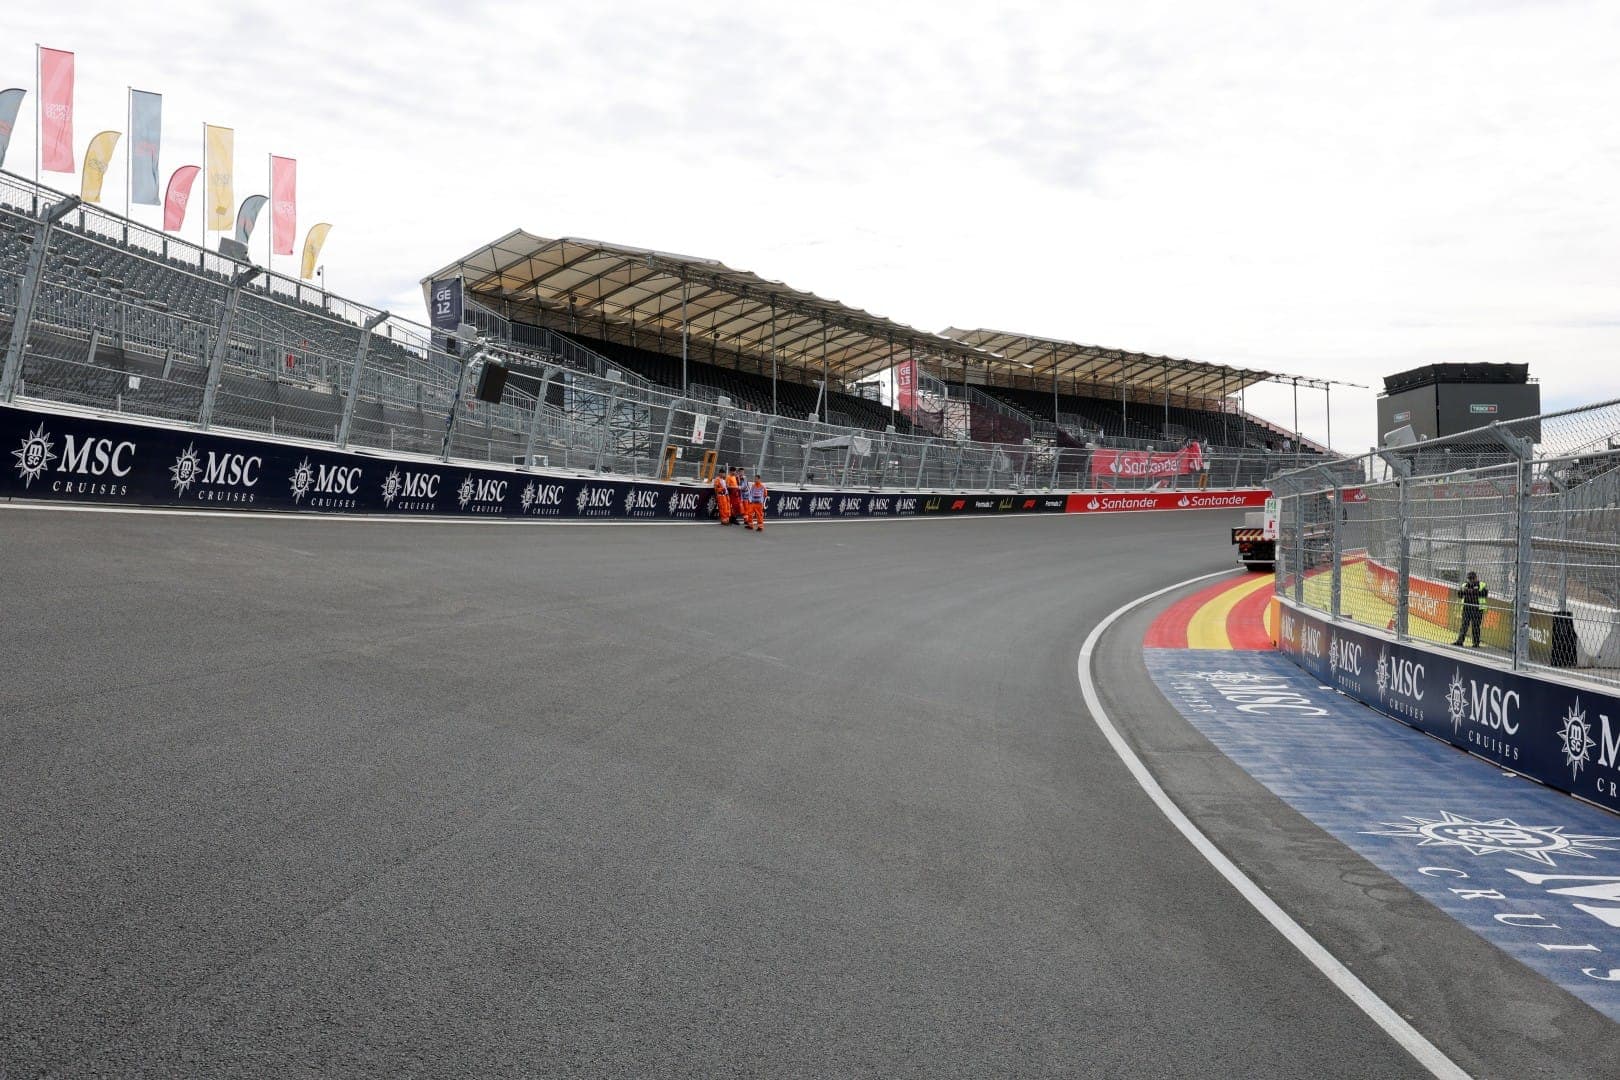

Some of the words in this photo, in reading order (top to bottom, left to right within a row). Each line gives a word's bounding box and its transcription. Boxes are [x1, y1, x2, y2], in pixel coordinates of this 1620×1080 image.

[437, 290, 451, 301] GE
[437, 302, 450, 315] 12
[56, 434, 136, 477] MSC
[202, 451, 262, 487] MSC
[52, 481, 127, 495] CRUISES
[314, 464, 362, 495] MSC
[402, 472, 440, 498] MSC
[198, 490, 255, 503] CRUISES
[475, 479, 507, 502] MSC
[535, 484, 564, 505] MSC
[589, 488, 614, 507] MSC
[636, 491, 658, 508] MSC
[311, 498, 355, 508] CRUISES
[678, 494, 699, 510] MSC
[785, 496, 801, 511] MSC
[816, 497, 832, 510] MSC
[1101, 497, 1159, 509] Santander
[1191, 495, 1246, 507] Santander
[1308, 626, 1320, 658] MSC
[1339, 639, 1361, 676] MSC
[1390, 656, 1424, 700] MSC
[1390, 698, 1424, 721] CRUISES
[1469, 680, 1519, 735] MSC
[1469, 730, 1519, 760] CRUISES
